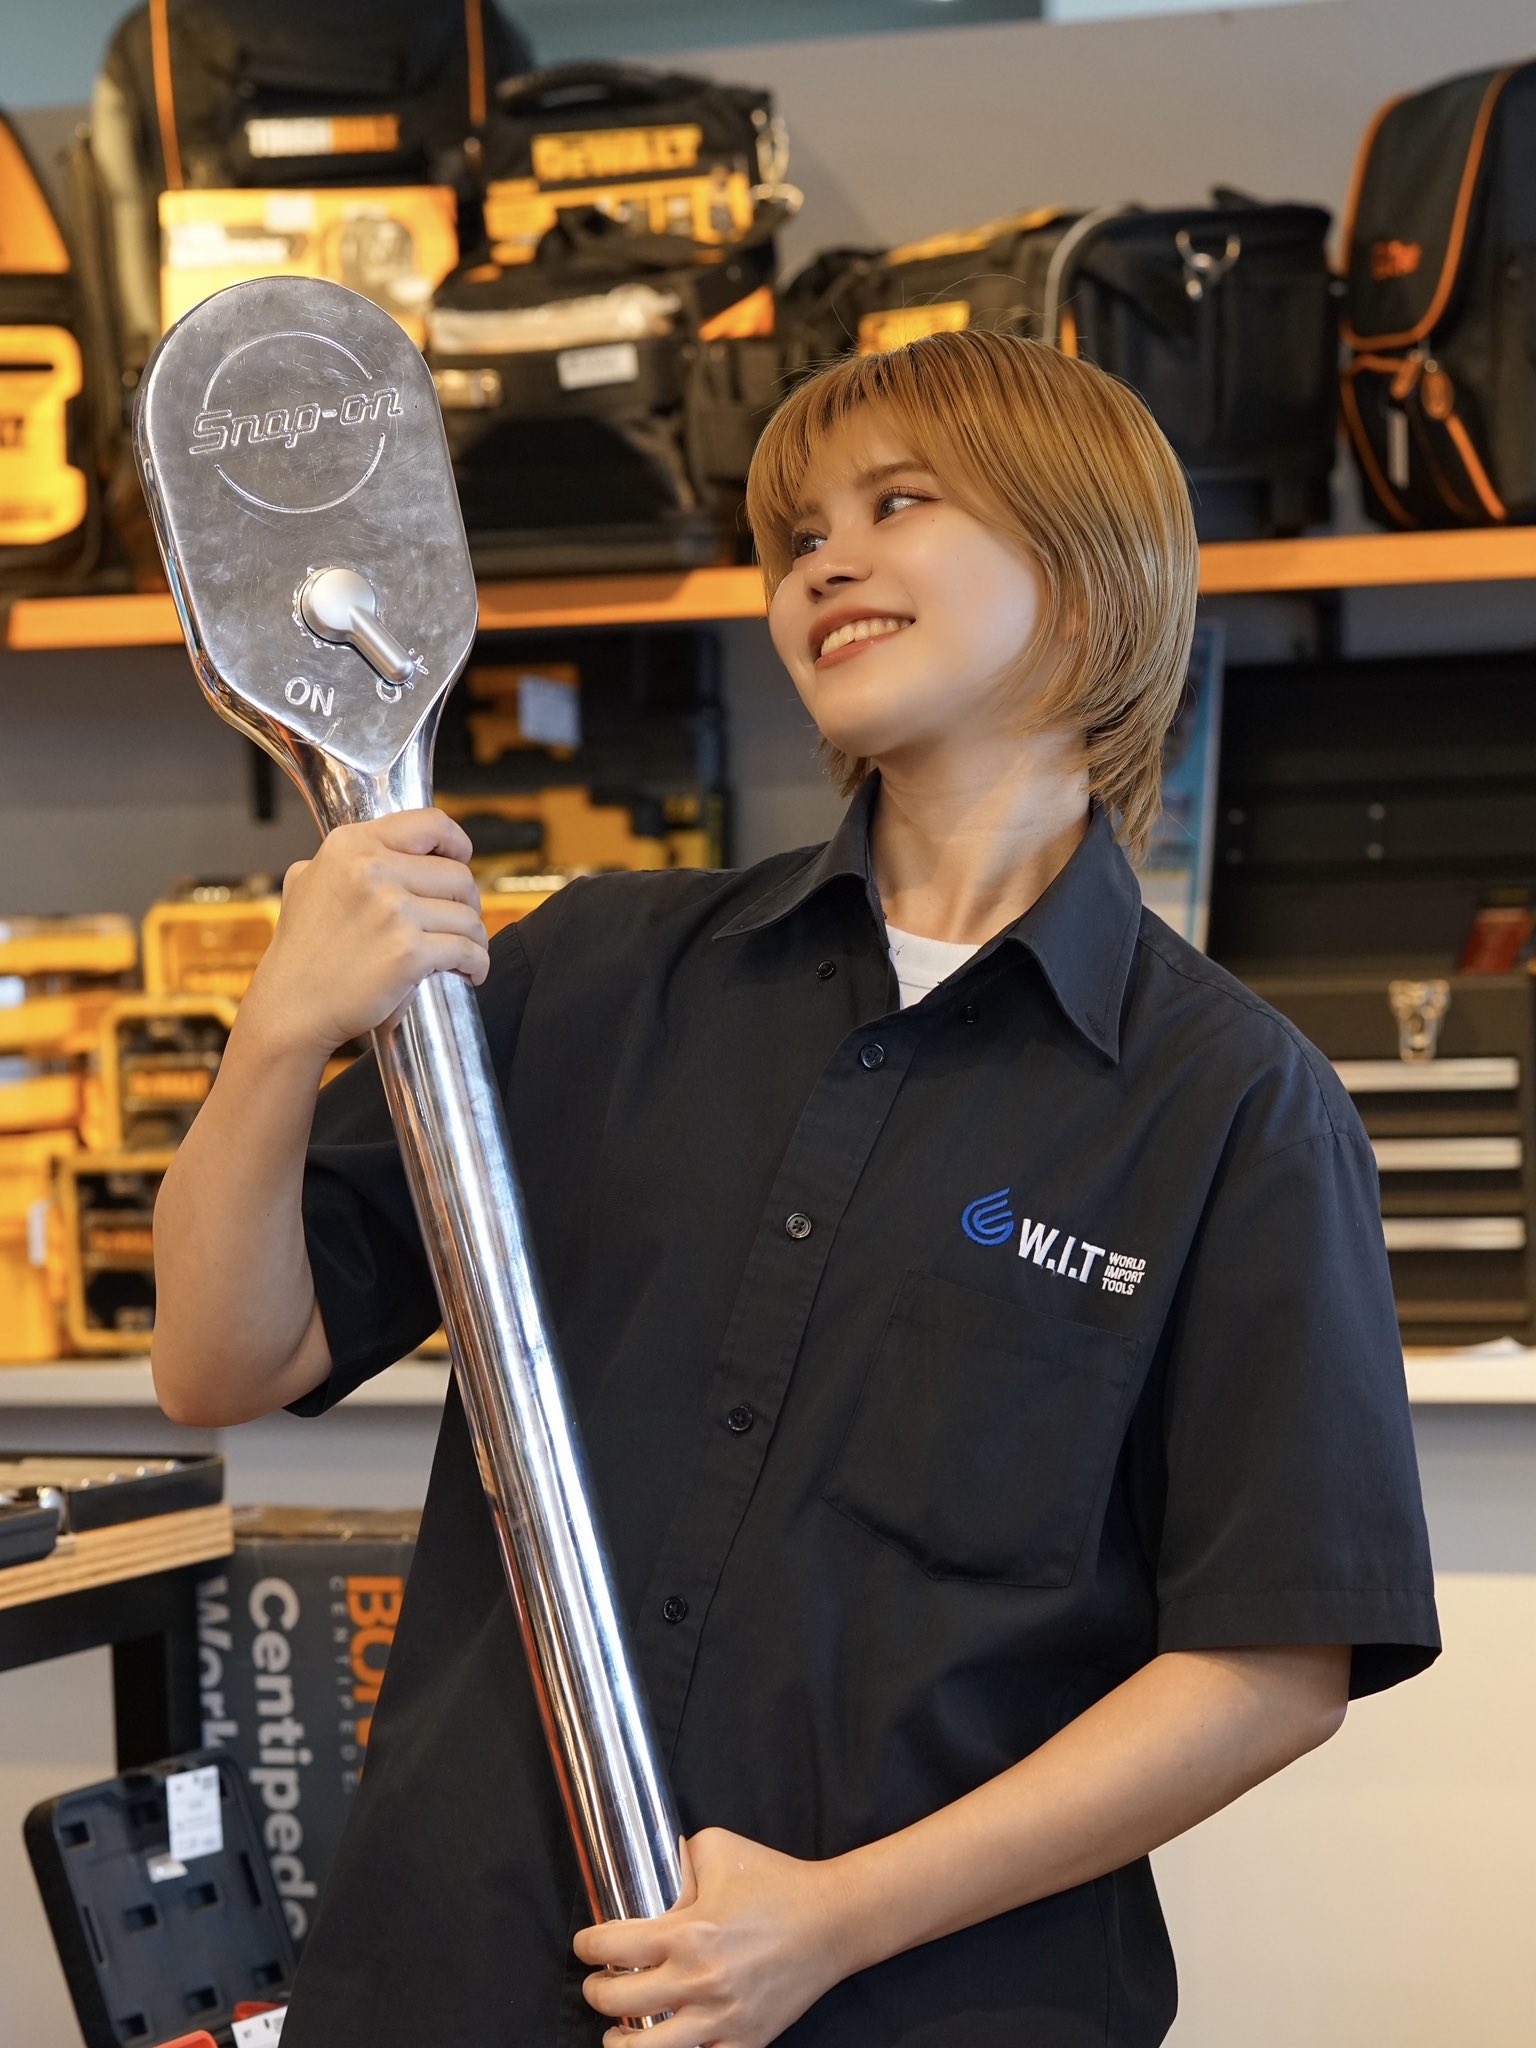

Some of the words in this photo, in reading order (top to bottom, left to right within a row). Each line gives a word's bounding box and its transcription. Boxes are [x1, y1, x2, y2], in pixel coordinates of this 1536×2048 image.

[189, 388, 404, 455] Snap-on
[284, 676, 335, 717] ON
[1018, 1218, 1106, 1284] W.I.T
[1109, 1253, 1146, 1270] WORLD
[1101, 1278, 1135, 1295] TOOLS
[1104, 1266, 1145, 1283] IMPORT
